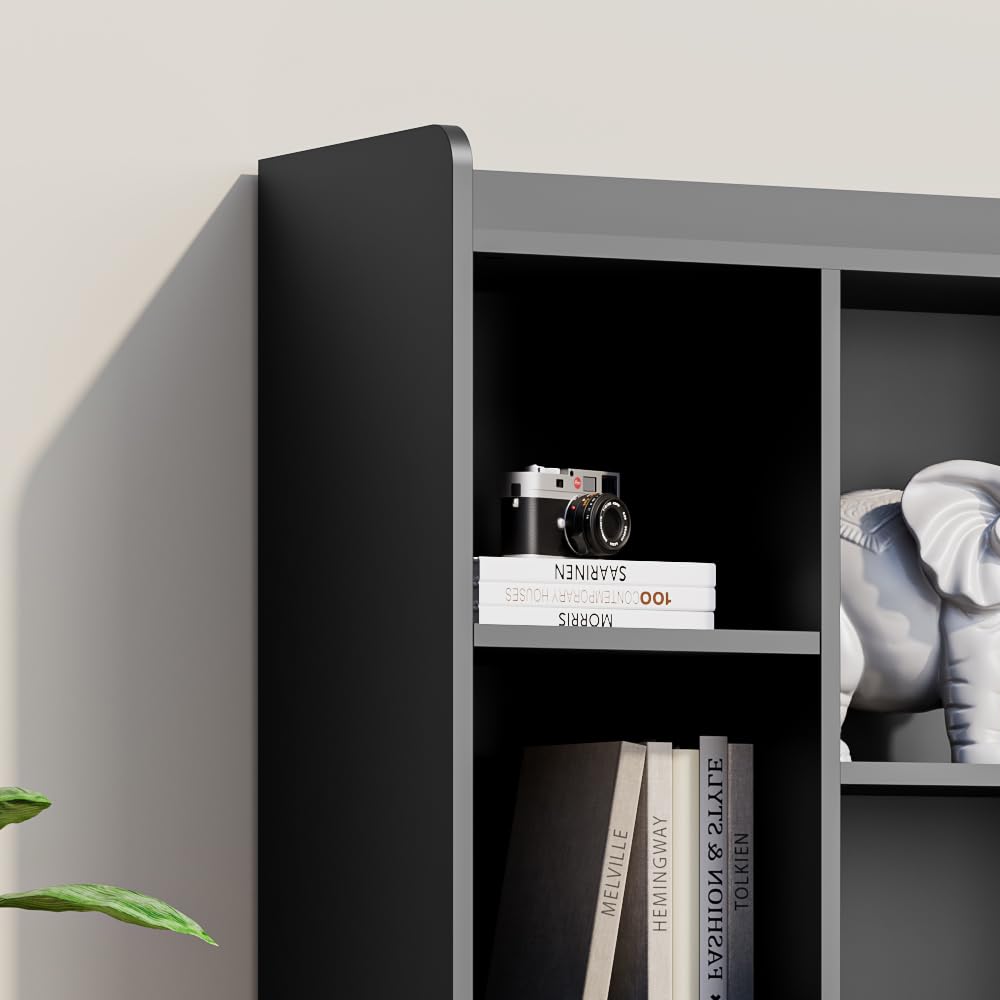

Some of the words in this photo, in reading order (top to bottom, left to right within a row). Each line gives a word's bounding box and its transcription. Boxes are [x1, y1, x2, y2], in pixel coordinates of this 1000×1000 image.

[554, 563, 627, 582] SAARINEN
[504, 586, 549, 603] HOUSES
[551, 587, 640, 604] CONTEMPORARY
[639, 591, 672, 606] 100
[558, 612, 613, 627] MORRIS
[601, 828, 629, 917] MELVILLE
[652, 815, 668, 932] HEMINGWAY
[734, 833, 750, 911] TOLKIEN
